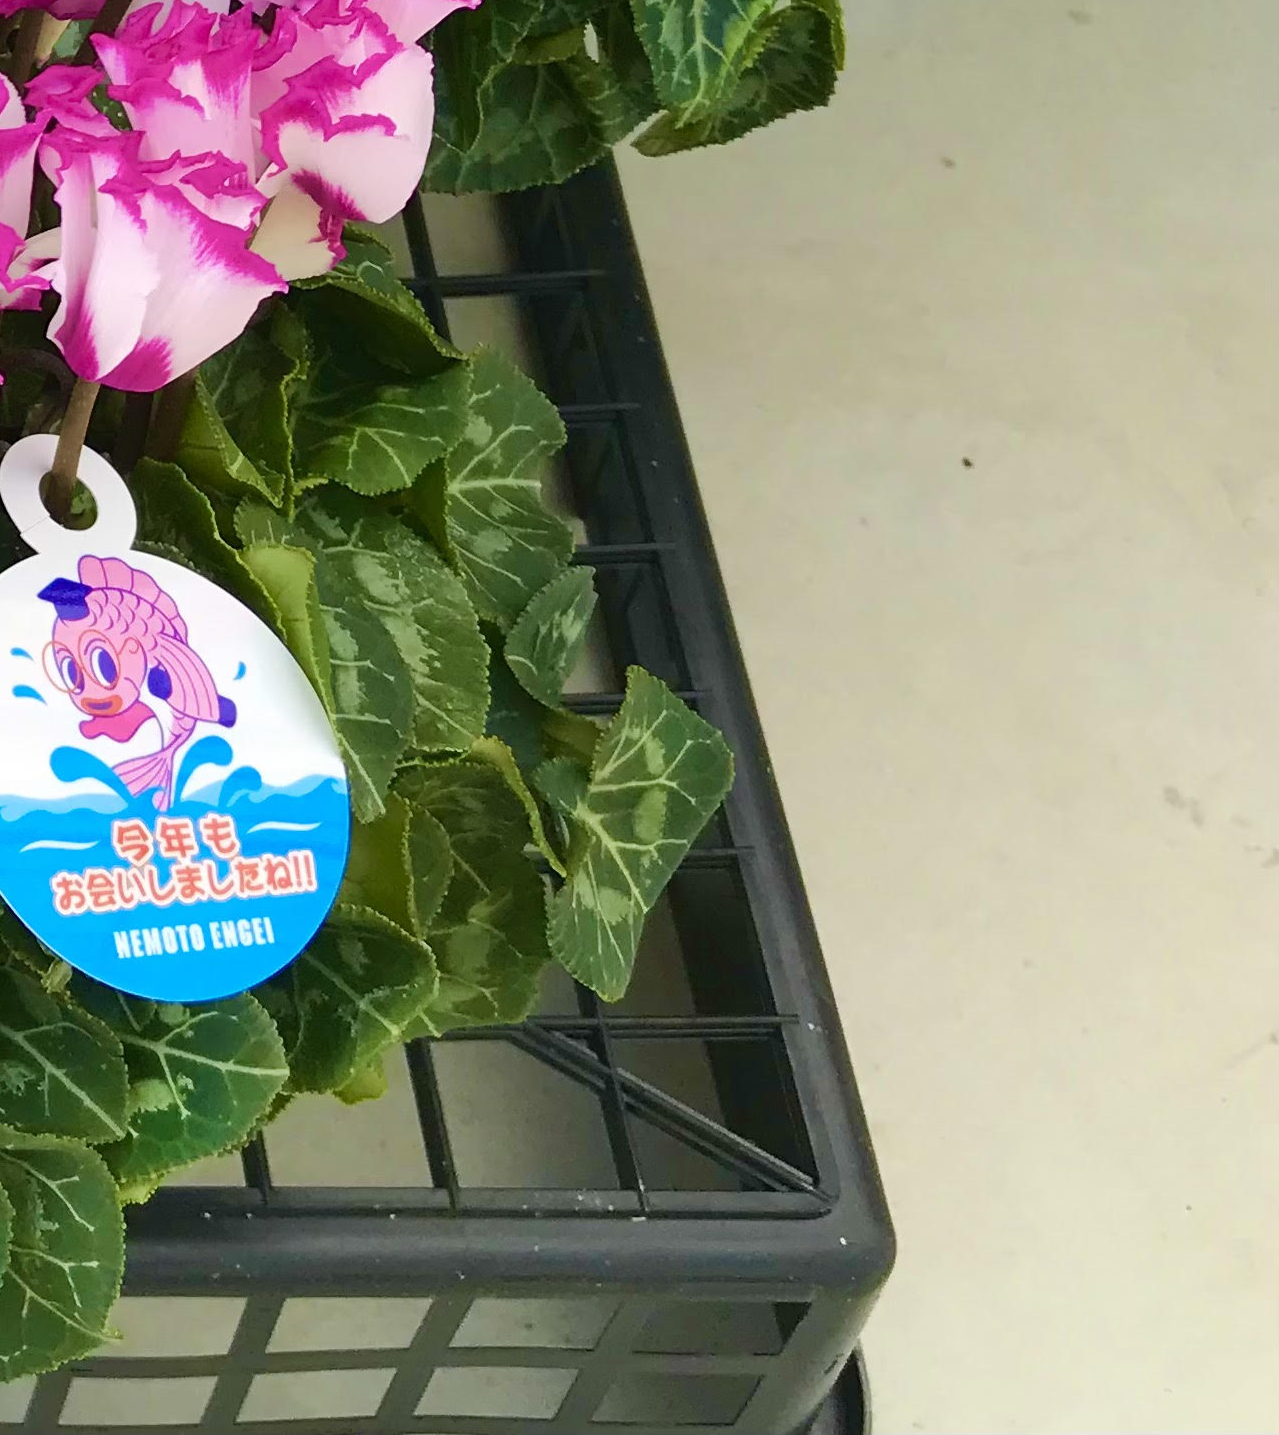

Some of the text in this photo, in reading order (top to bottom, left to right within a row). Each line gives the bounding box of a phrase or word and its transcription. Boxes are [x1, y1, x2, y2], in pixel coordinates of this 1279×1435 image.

[112, 813, 239, 862] 今年も
[113, 917, 276, 959] NEMOTO ENGEI
